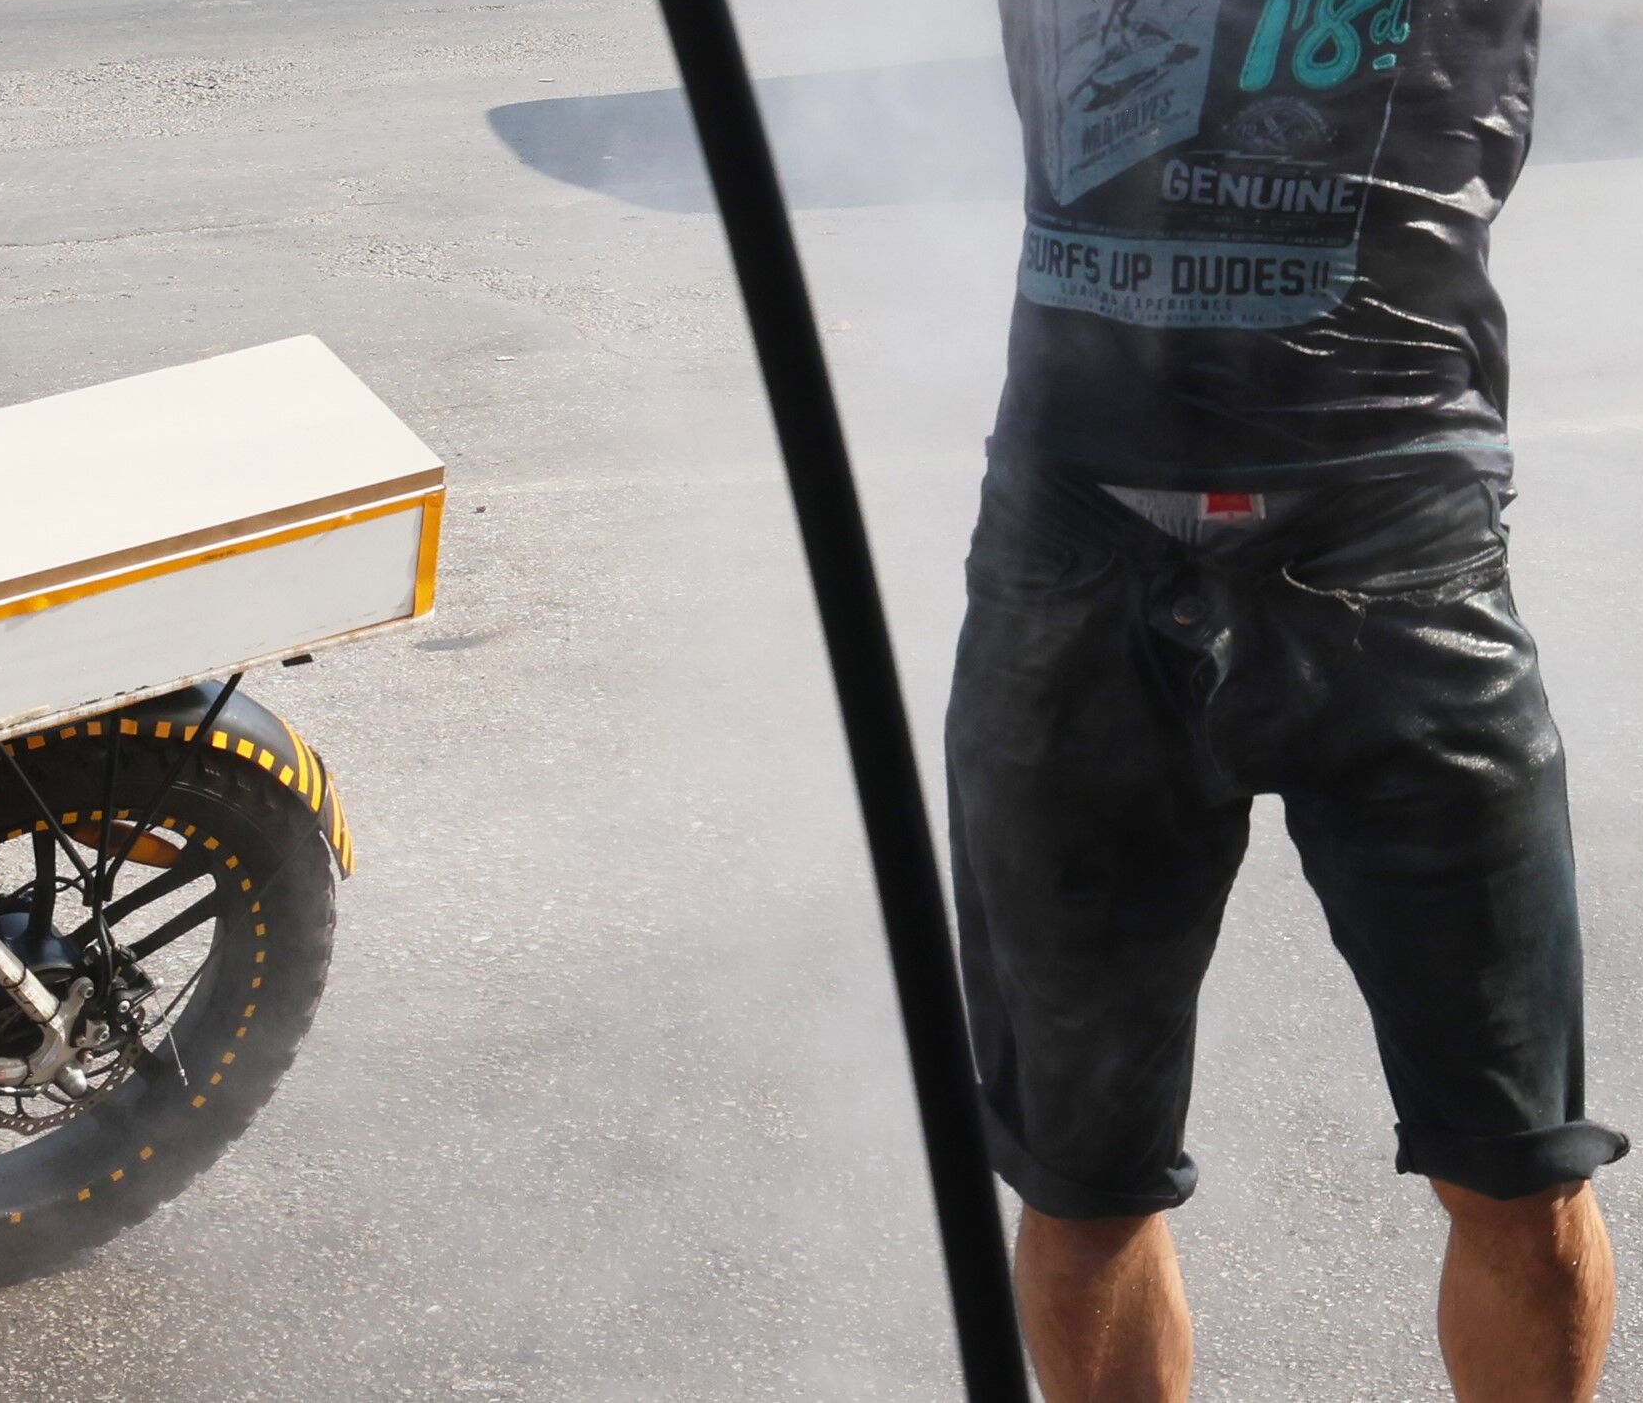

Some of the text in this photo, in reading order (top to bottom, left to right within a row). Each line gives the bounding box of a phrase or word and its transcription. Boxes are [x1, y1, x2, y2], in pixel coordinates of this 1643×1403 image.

[1161, 158, 1357, 214] GENUINE
[1026, 231, 1101, 285] SURFS
[1109, 250, 1153, 293] UP
